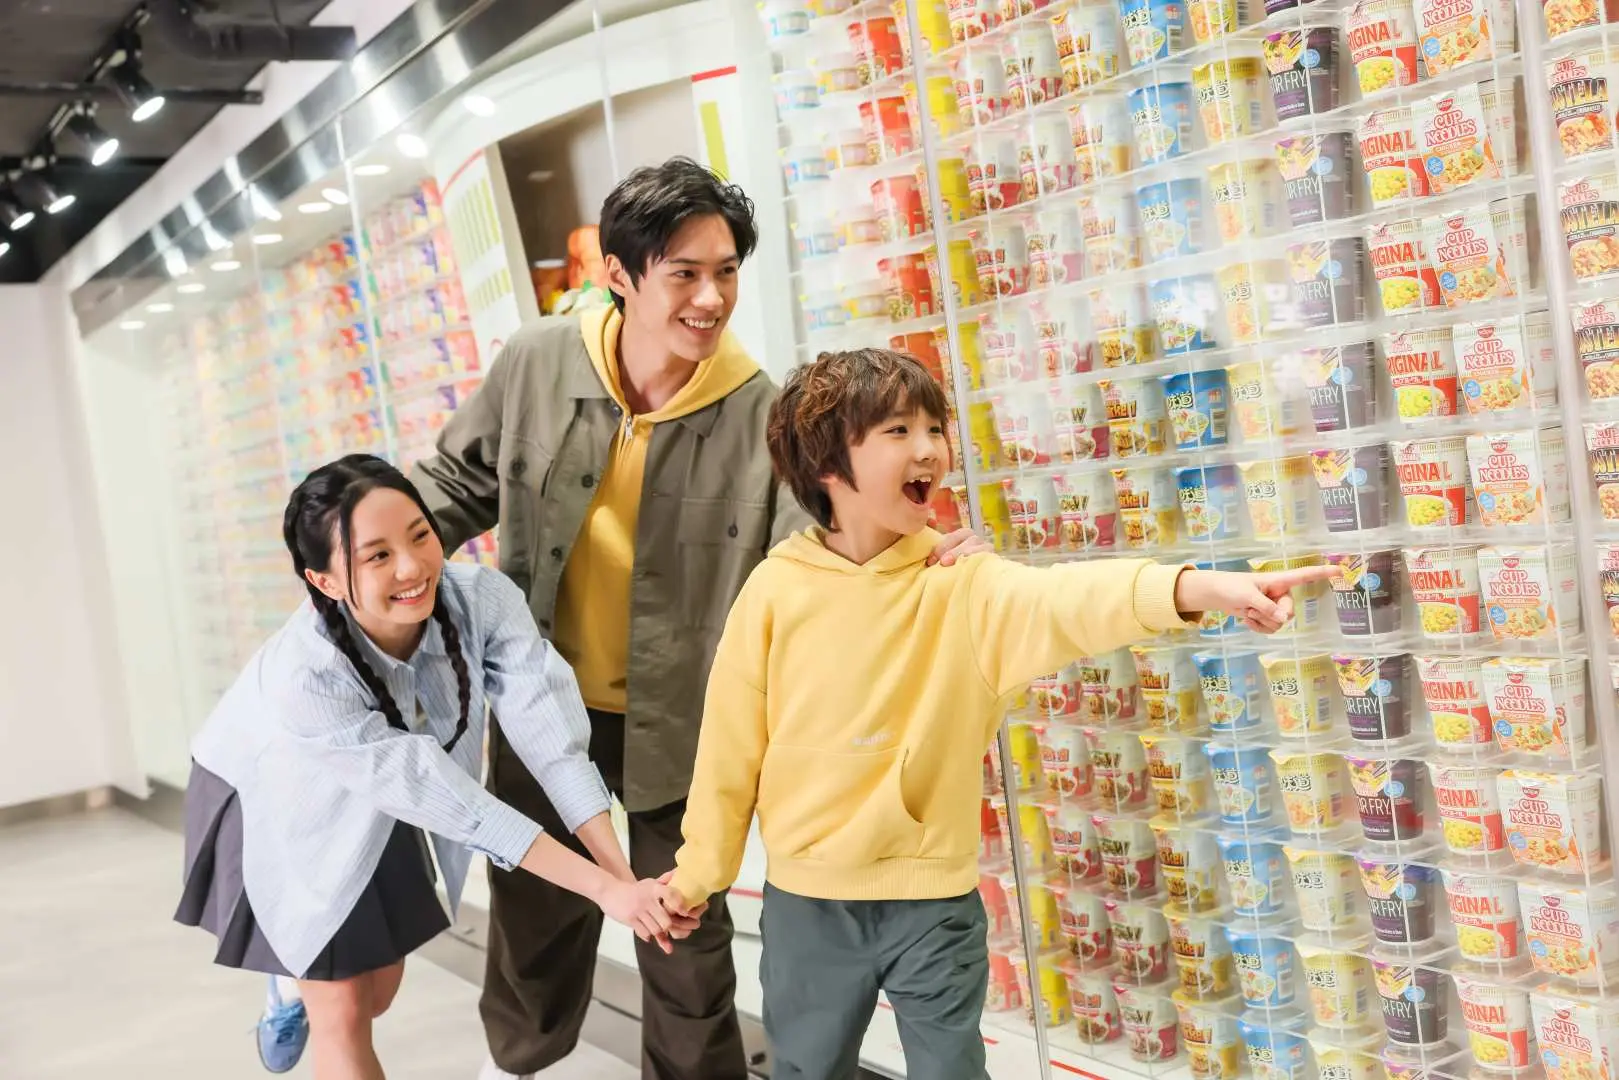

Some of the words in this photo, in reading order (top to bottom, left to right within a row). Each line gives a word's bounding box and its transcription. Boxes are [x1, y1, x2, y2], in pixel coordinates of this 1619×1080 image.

[1285, 69, 1307, 91] FRY
[1433, 110, 1463, 129] CUP
[1424, 118, 1477, 147] NOODLES
[1299, 175, 1320, 196] FRY
[1445, 228, 1474, 246] CUP
[1436, 238, 1489, 263] NOODLES
[1473, 338, 1503, 354] CUP
[1464, 350, 1516, 370] NOODLES
[1487, 453, 1517, 469] CUP
[1478, 465, 1530, 482] NOODLES
[1334, 487, 1355, 504] FRY
[1498, 569, 1528, 583] CUP
[1489, 581, 1542, 597] NOODLES
[1346, 591, 1368, 609] FRY
[1503, 684, 1532, 699] CUP
[1358, 697, 1380, 715] FRY
[1369, 797, 1391, 815] FRY
[1518, 798, 1549, 813] CUP
[1382, 900, 1404, 917] FRY
[1540, 906, 1570, 923] CUP
[1391, 1000, 1412, 1018] FRY
